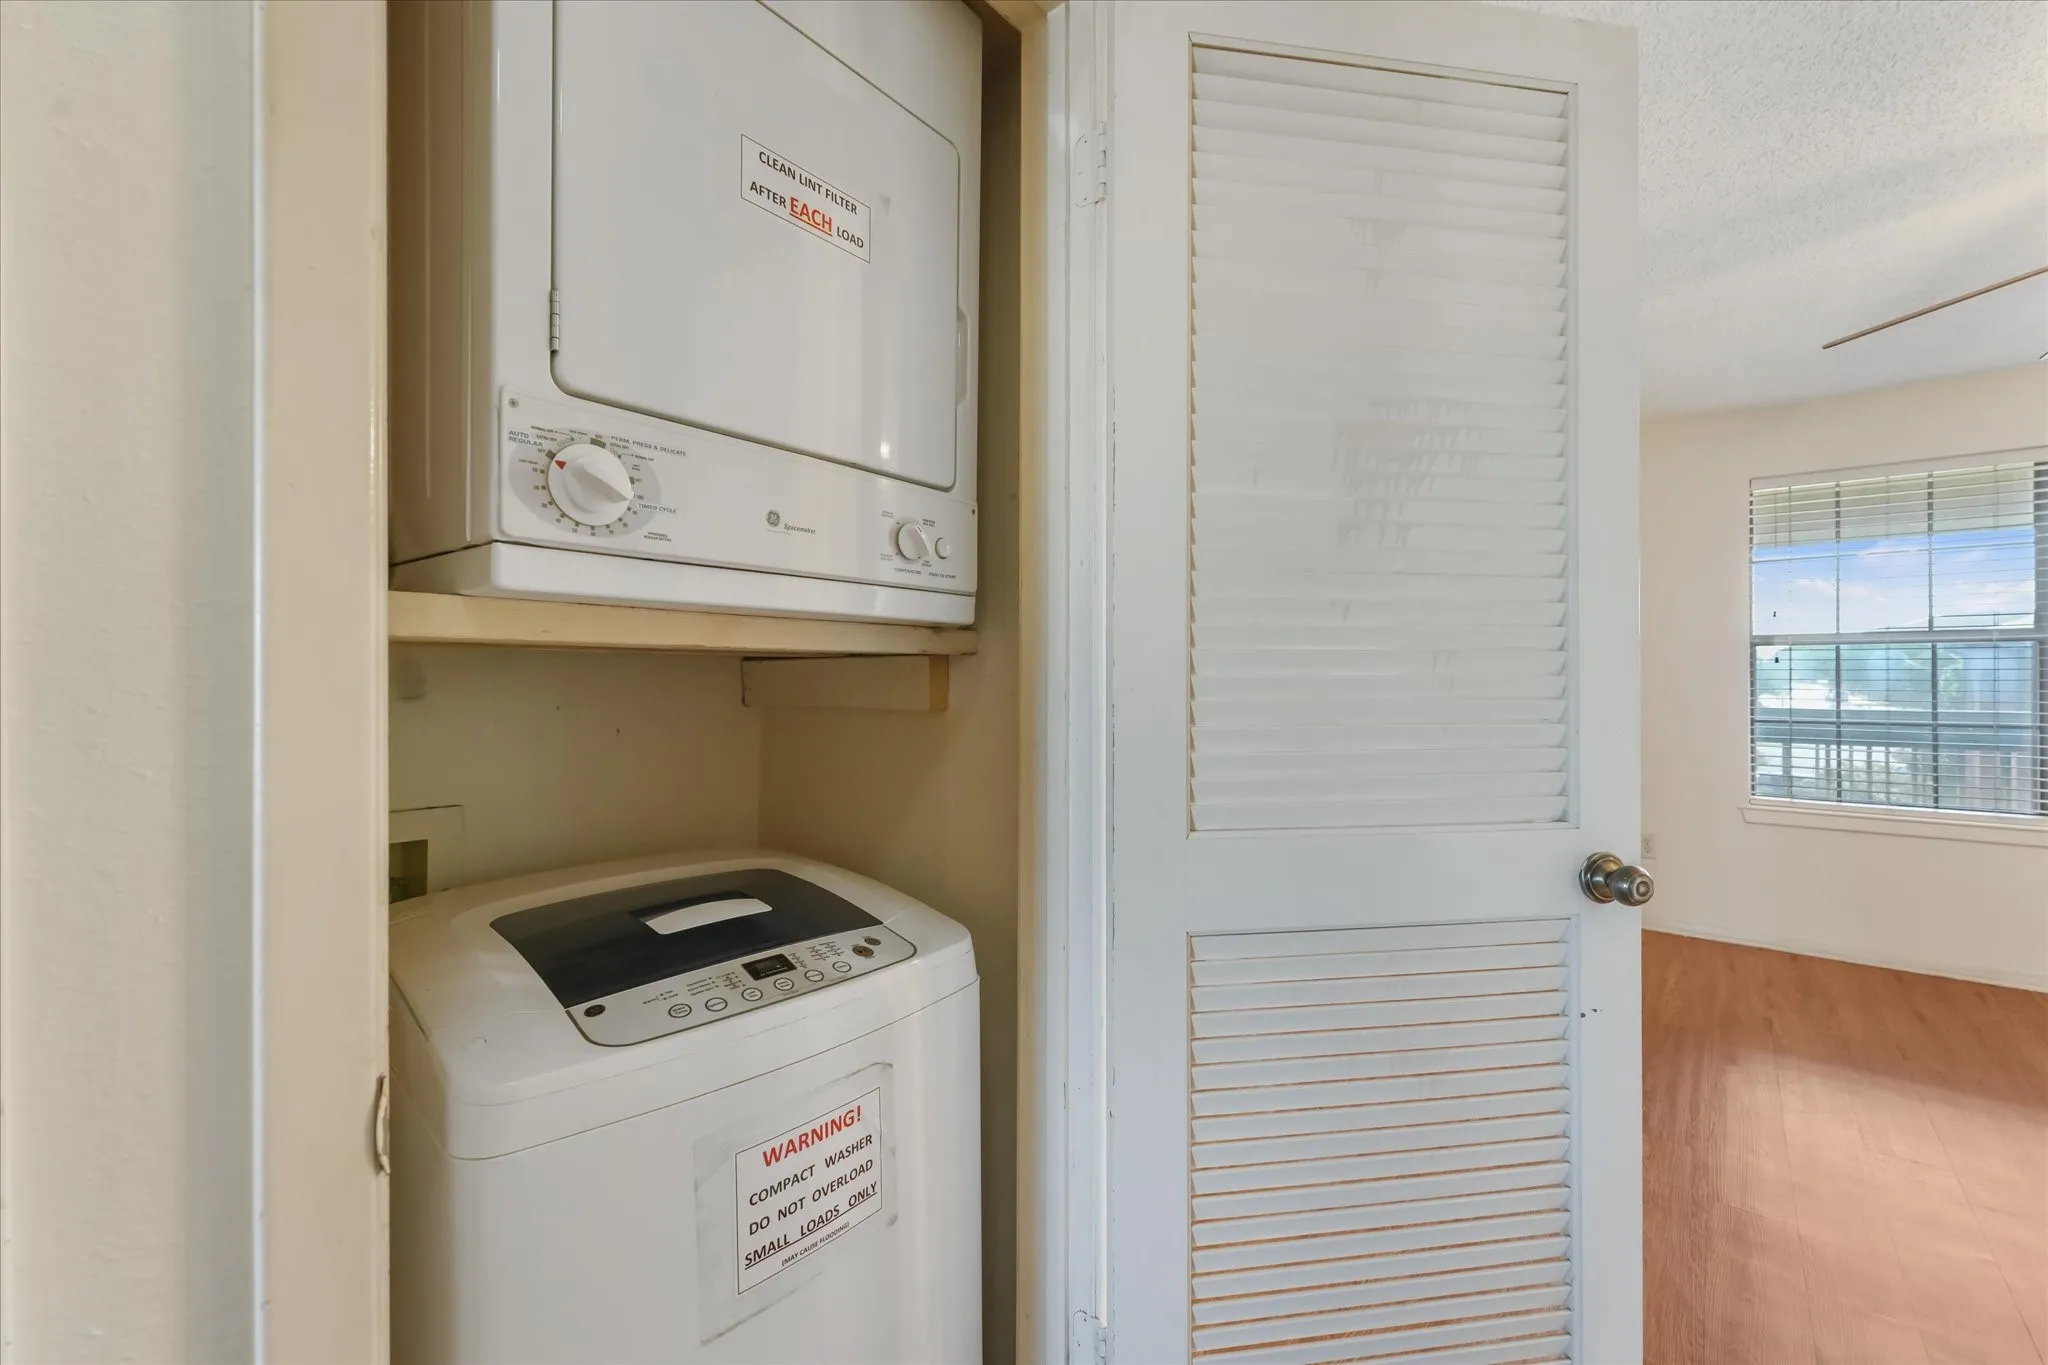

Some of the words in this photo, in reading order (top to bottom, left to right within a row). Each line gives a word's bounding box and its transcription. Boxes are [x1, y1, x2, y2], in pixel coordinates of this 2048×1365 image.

[759, 151, 796, 180] CLEAN
[799, 173, 823, 195] LINT
[825, 188, 858, 215] FILTER
[749, 181, 786, 209] AFTER
[789, 196, 833, 236] EACH
[837, 226, 864, 249] LOAD
[508, 430, 529, 439] AUTO
[508, 436, 543, 448] REGULAR
[632, 440, 653, 449] PRESS
[660, 446, 687, 457] DELICATE
[638, 502, 658, 511] TIMED
[658, 506, 677, 514] CYCLE
[784, 522, 816, 535] Spacemaker
[762, 1105, 862, 1167] WARNING!
[749, 1164, 816, 1207] COMPACT
[824, 1134, 873, 1169] WASHER
[749, 1216, 770, 1236] DO
[777, 1197, 806, 1221] NOT
[812, 1159, 873, 1202] OVERLOAD
[744, 1233, 791, 1268] SMALL
[800, 1204, 840, 1237] LOADS
[848, 1181, 878, 1207] ONLY
[781, 1252, 799, 1268] (MAY
[799, 1240, 819, 1256] CAUSE
[819, 1221, 850, 1246] FLOODING)
